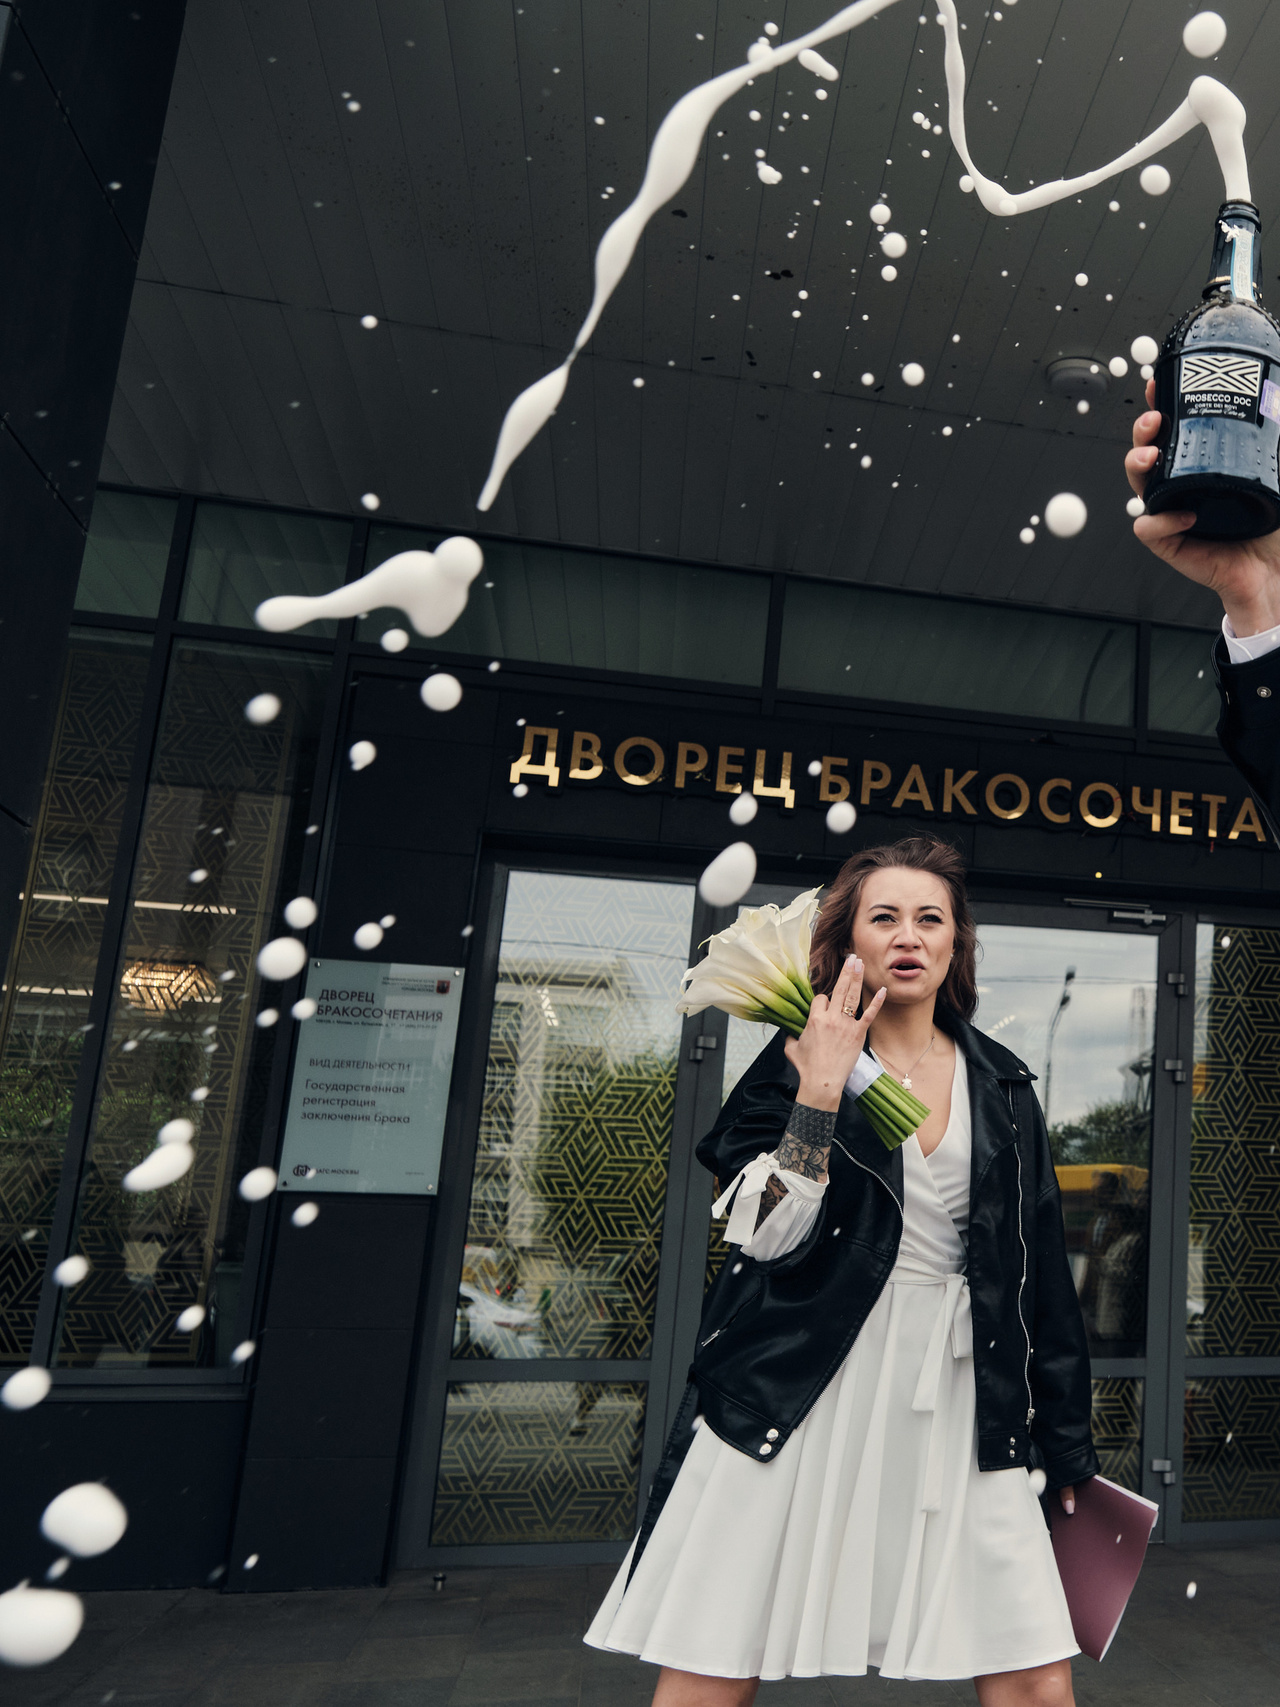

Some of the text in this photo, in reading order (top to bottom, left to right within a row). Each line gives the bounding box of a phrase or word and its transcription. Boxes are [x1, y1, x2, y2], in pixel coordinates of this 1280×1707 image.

[1184, 393, 1252, 407] PROSECCO DOC
[509, 725, 1274, 843] ДВОРЕЦ БРАКОСОЧЕТА
[318, 988, 375, 1004] ДВОРЕЦ
[315, 1004, 443, 1022] БРАКОСОЧЕТАНИЯ
[309, 1058, 411, 1071] ВИД ДЕЯТЕЛЬНОСТИ
[305, 1079, 405, 1094] Государственная
[302, 1096, 376, 1108] регистрация
[300, 1111, 411, 1125] заключения брака
